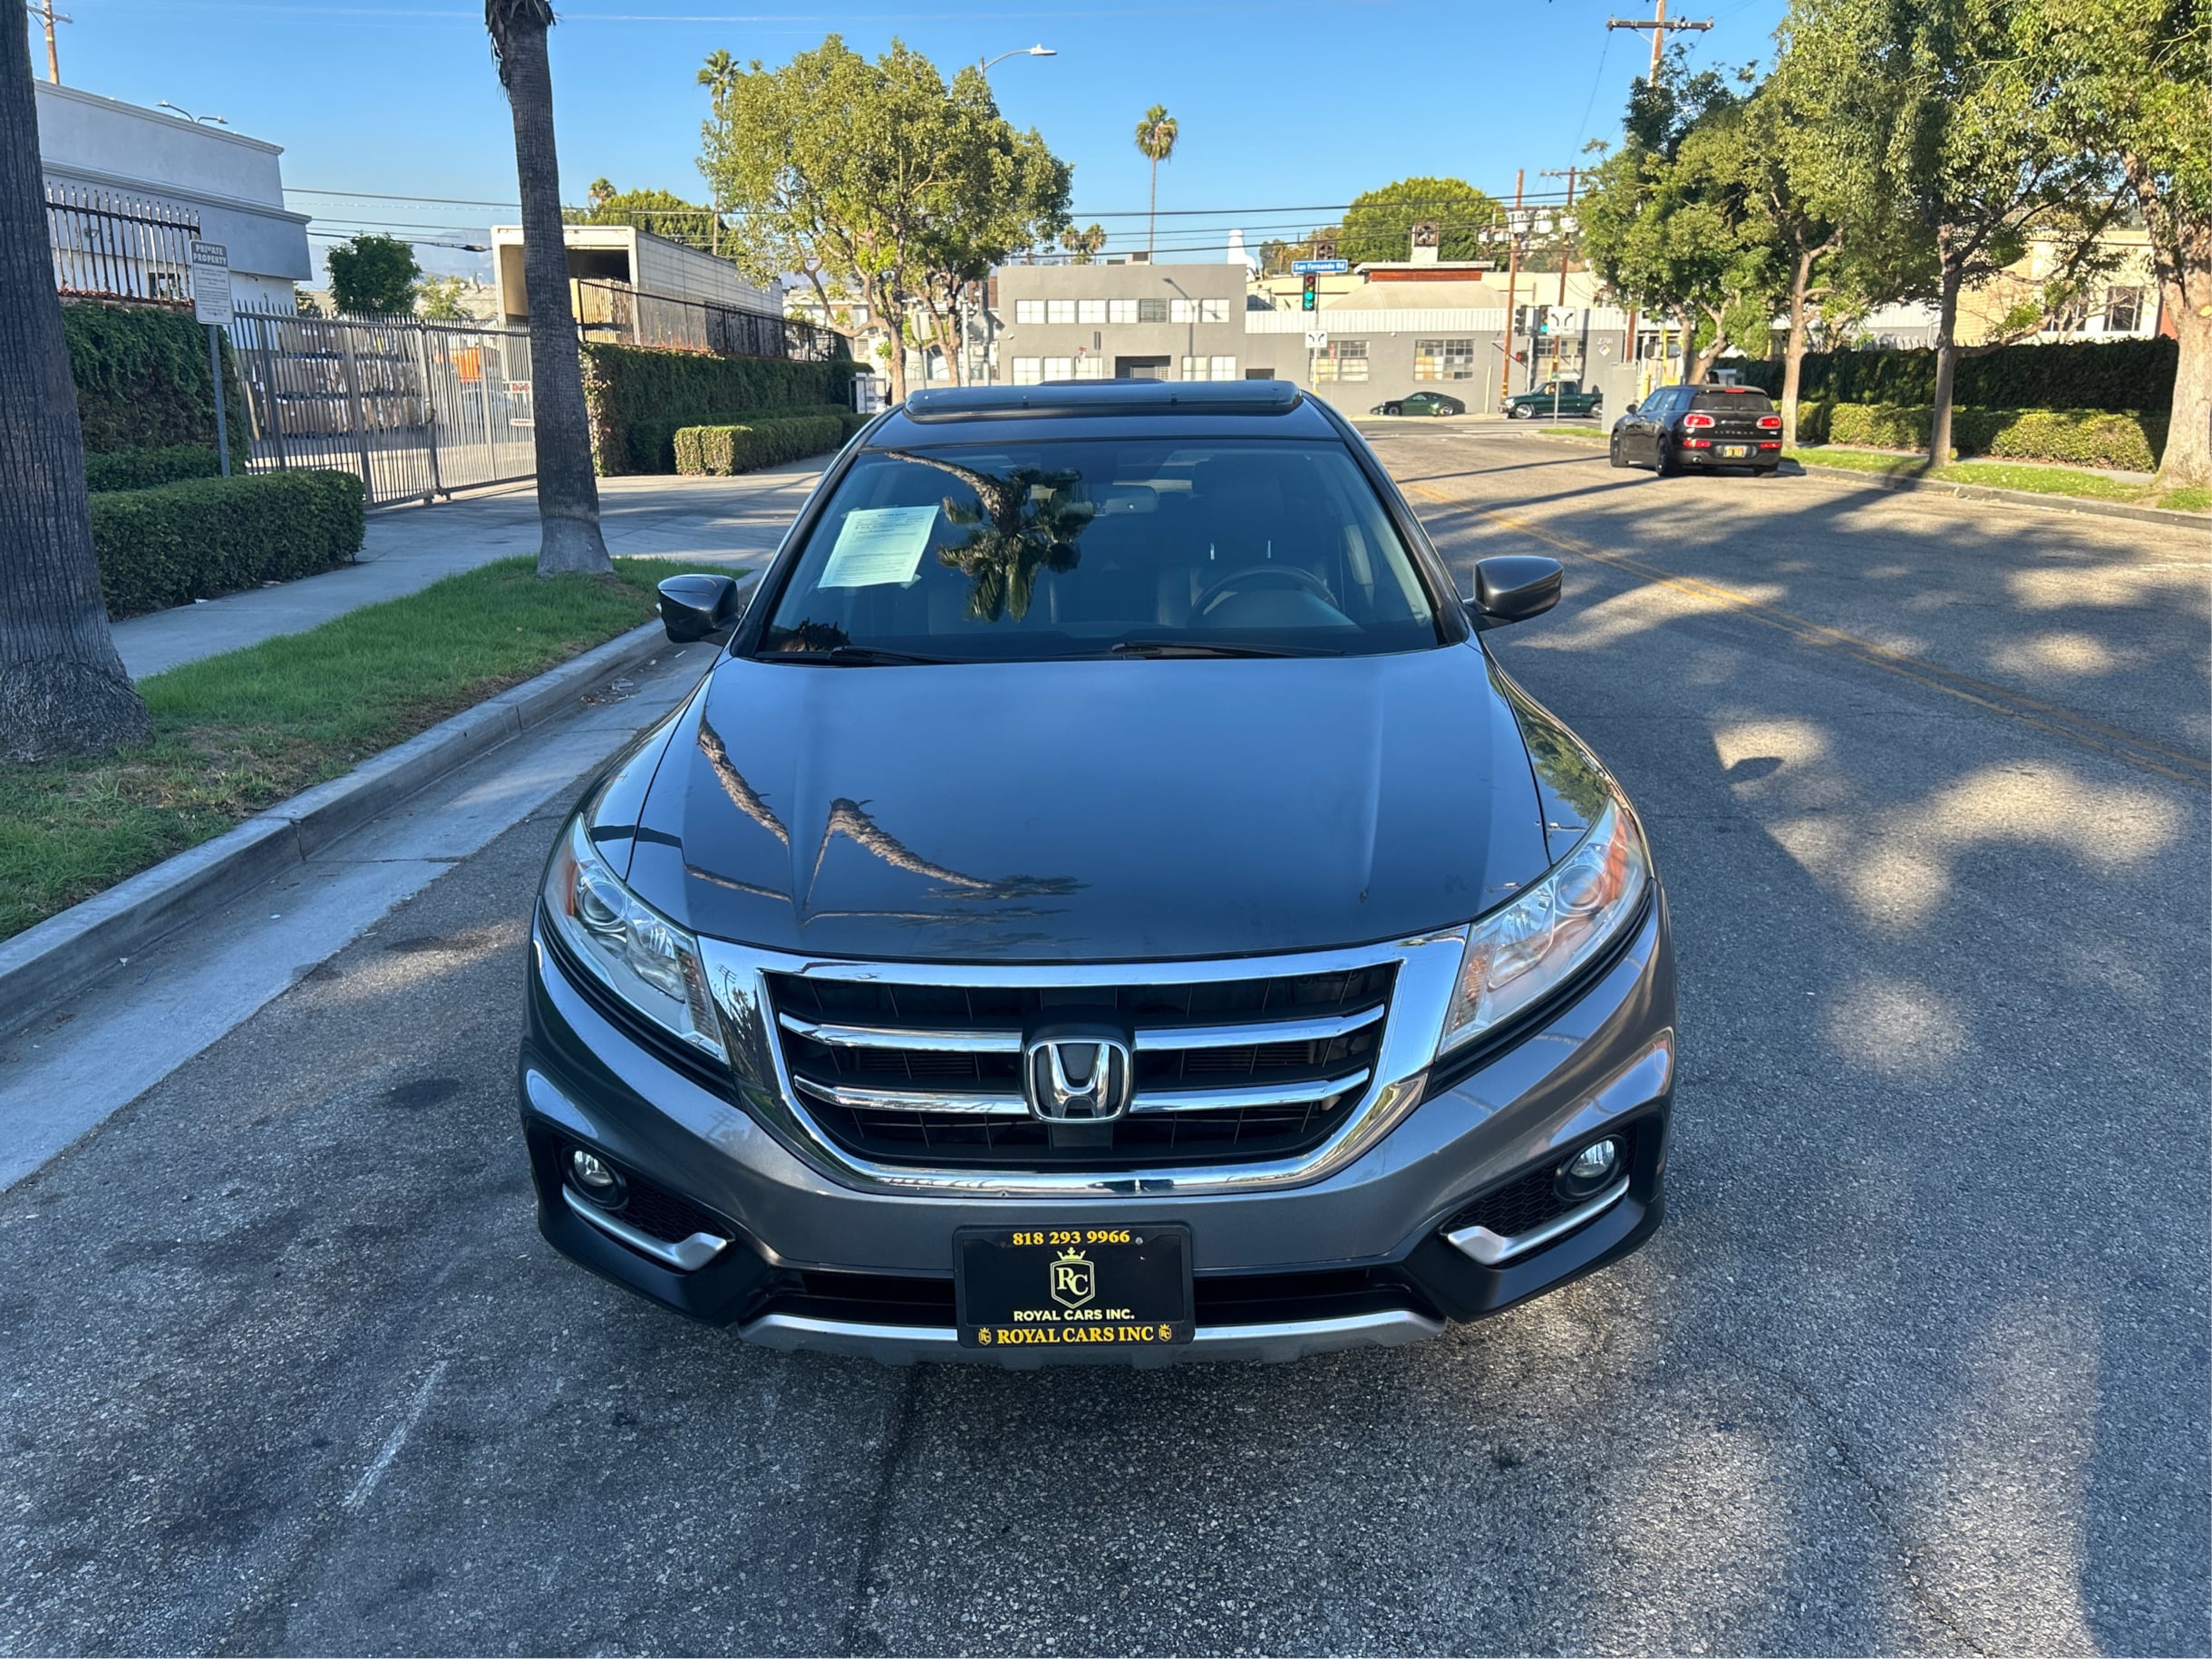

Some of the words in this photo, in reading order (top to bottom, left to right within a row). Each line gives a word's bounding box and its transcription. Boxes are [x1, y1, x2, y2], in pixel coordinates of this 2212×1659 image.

[195, 244, 224, 256] PRIVATE
[193, 252, 227, 266] PROPERTY
[1013, 1232, 1044, 1246] 818
[1049, 1231, 1082, 1245] 293
[1086, 1230, 1130, 1244] 9966
[1056, 1266, 1089, 1296] RC
[1013, 1310, 1061, 1322] ROYAL
[1063, 1309, 1102, 1321] CARS
[1106, 1308, 1135, 1320] INC.
[996, 1327, 1061, 1344] ROYAL
[1062, 1327, 1114, 1343] CARS
[1118, 1326, 1154, 1342] INC
